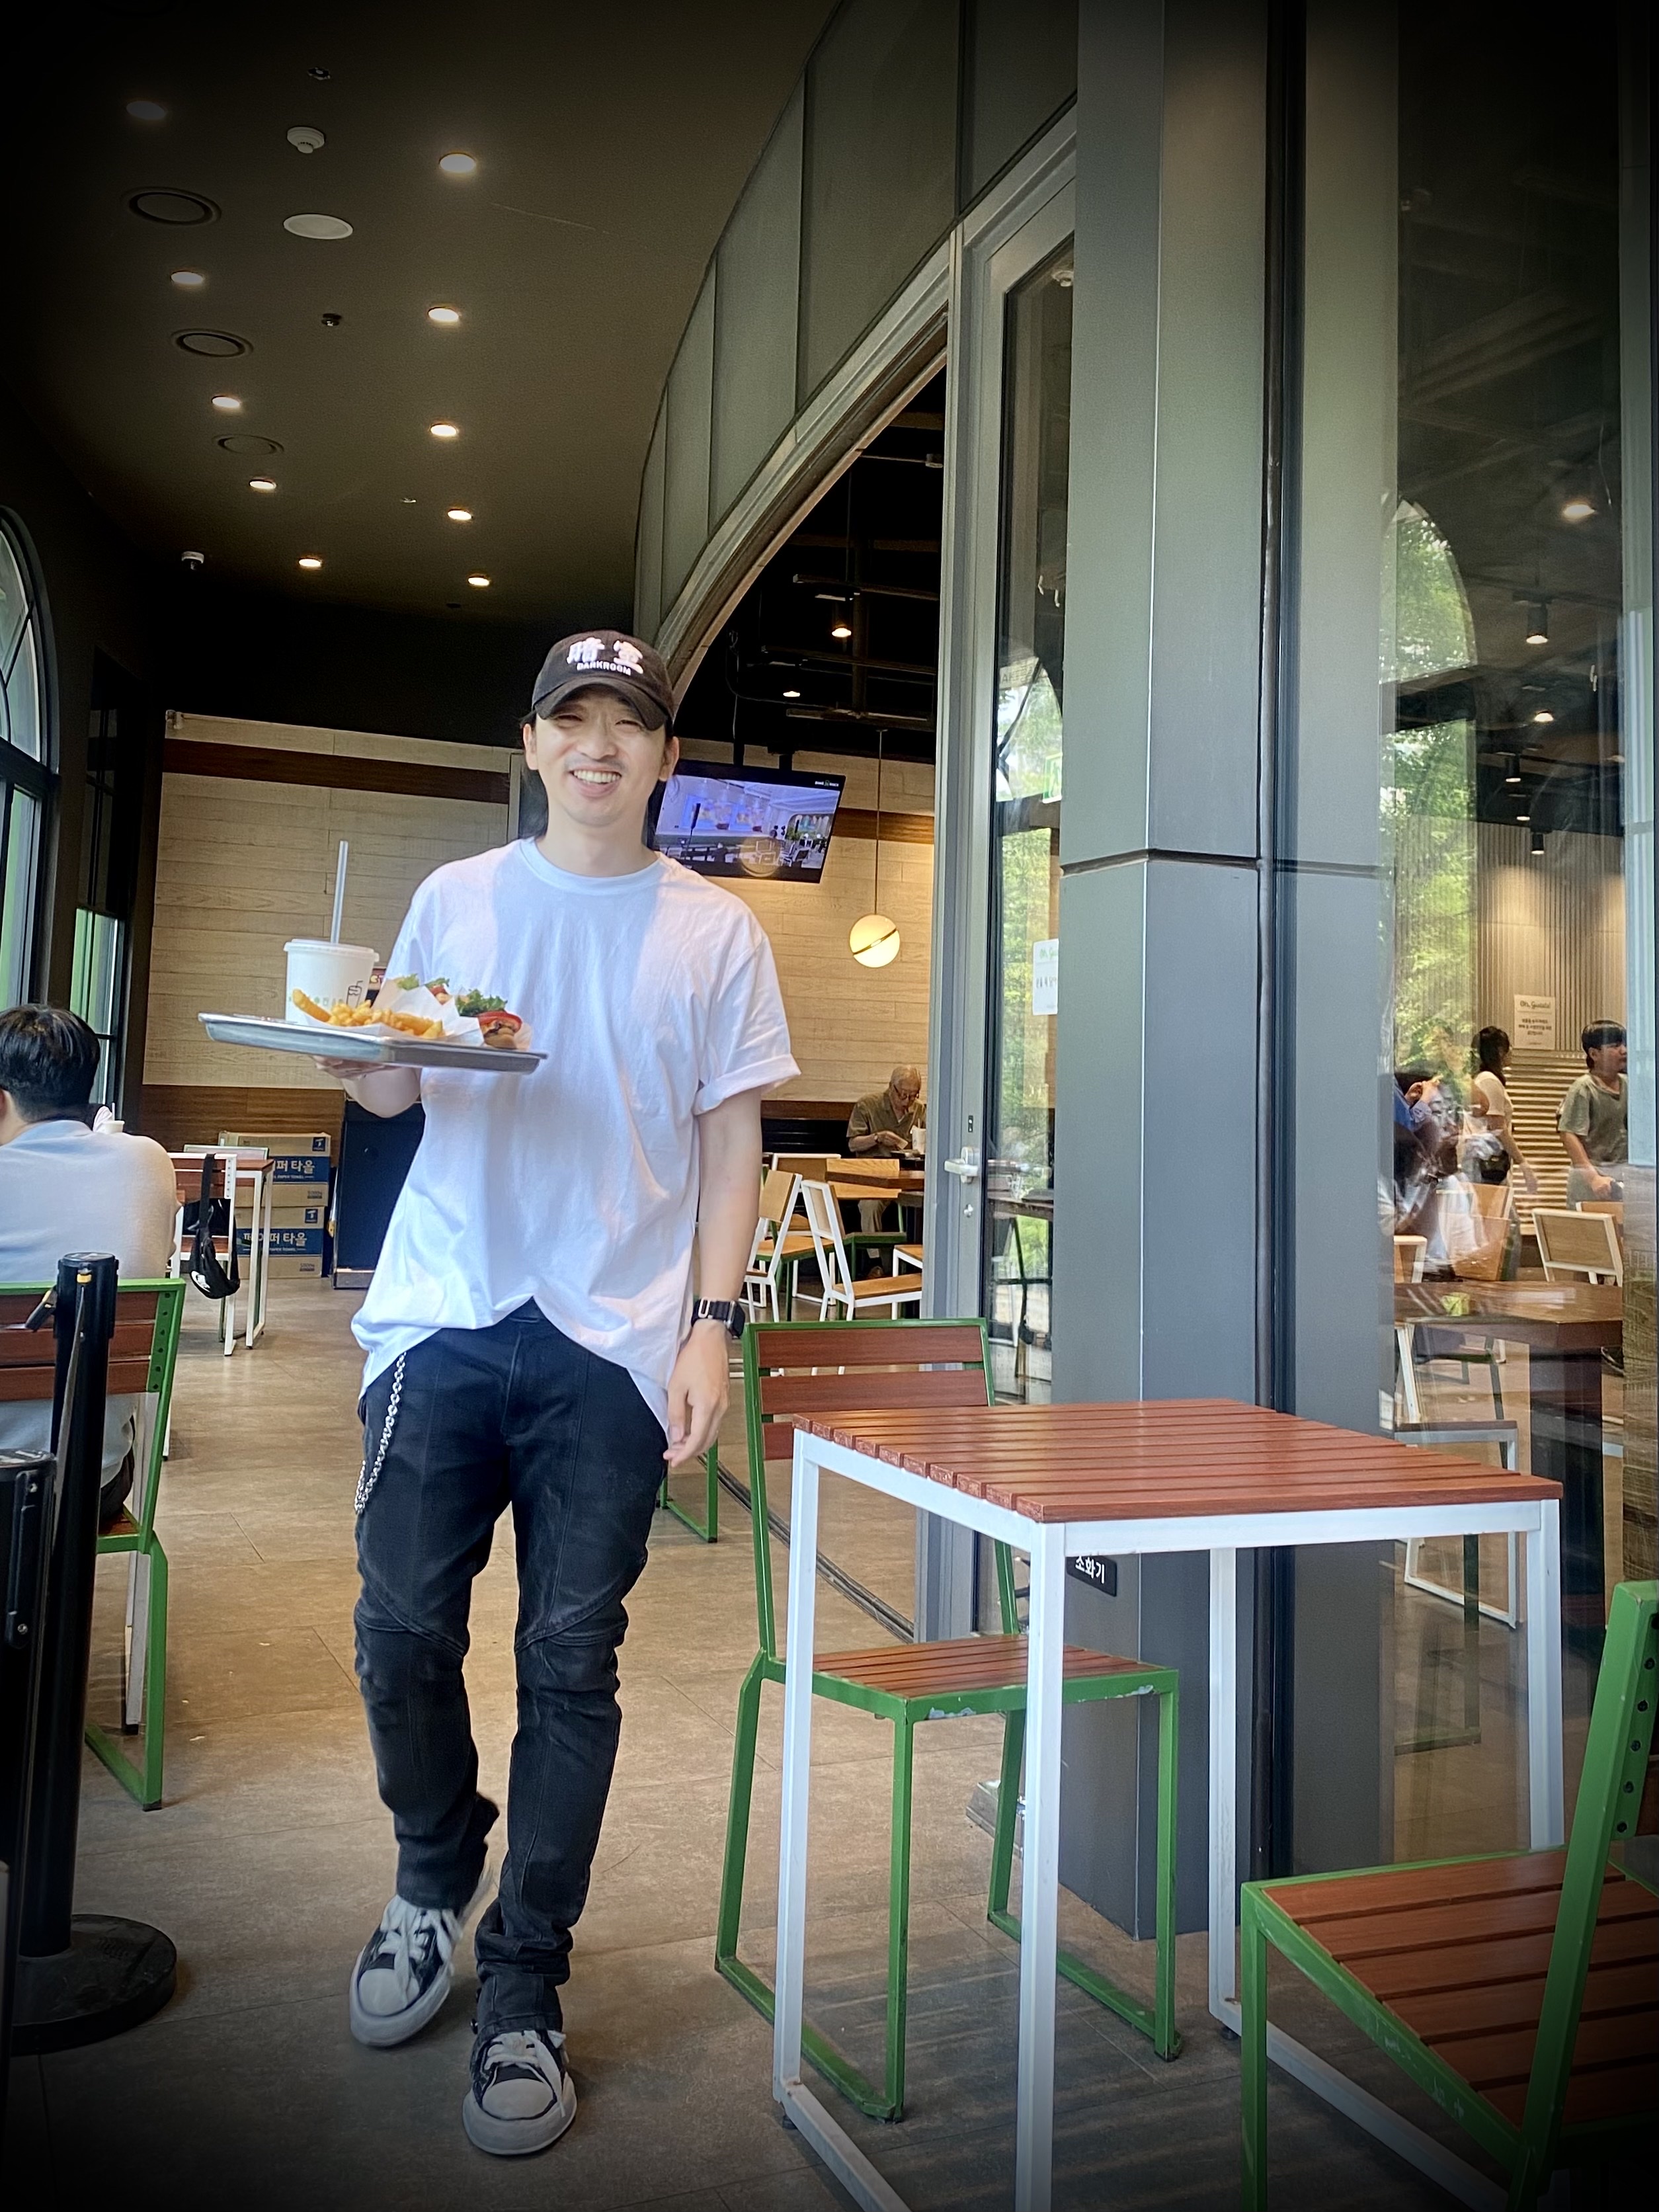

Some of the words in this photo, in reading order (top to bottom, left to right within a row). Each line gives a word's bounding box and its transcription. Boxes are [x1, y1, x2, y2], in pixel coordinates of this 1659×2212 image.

[577, 660, 631, 676] DARKROOM
[291, 1159, 315, 1174] 타올
[283, 1232, 307, 1247] 타올
[1075, 1555, 1105, 1584] 소화기
